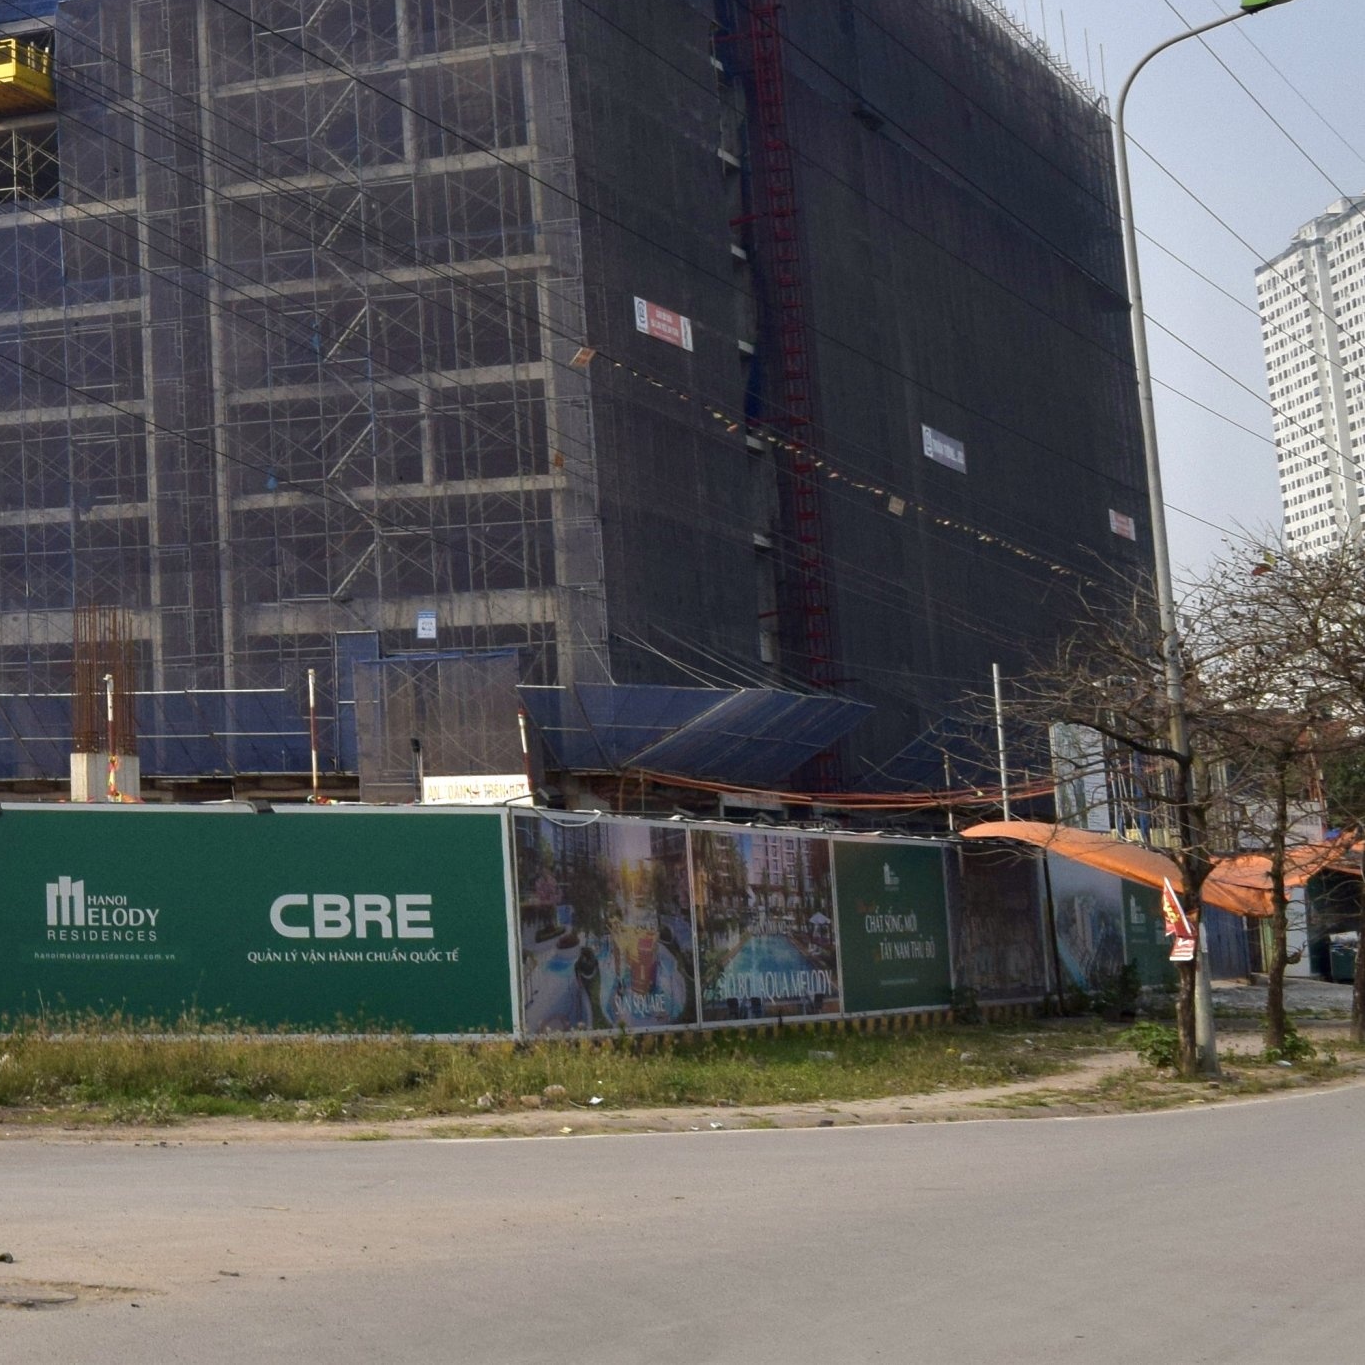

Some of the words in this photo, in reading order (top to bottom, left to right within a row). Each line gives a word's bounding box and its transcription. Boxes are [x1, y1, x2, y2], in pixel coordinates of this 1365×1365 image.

[87, 895, 128, 906] HANOI
[270, 894, 434, 939] CBRE
[47, 930, 157, 942] RESIDENCES
[34, 952, 176, 961] hanoimelodyresidences.com.vn
[247, 948, 282, 963] QUẢN
[285, 949, 298, 962] LÝ
[302, 949, 325, 964] VẬN
[329, 949, 363, 962] HÀNH
[366, 947, 407, 962] CHUẨN
[410, 947, 443, 963] QUỐC
[446, 947, 460, 961] TẾ
